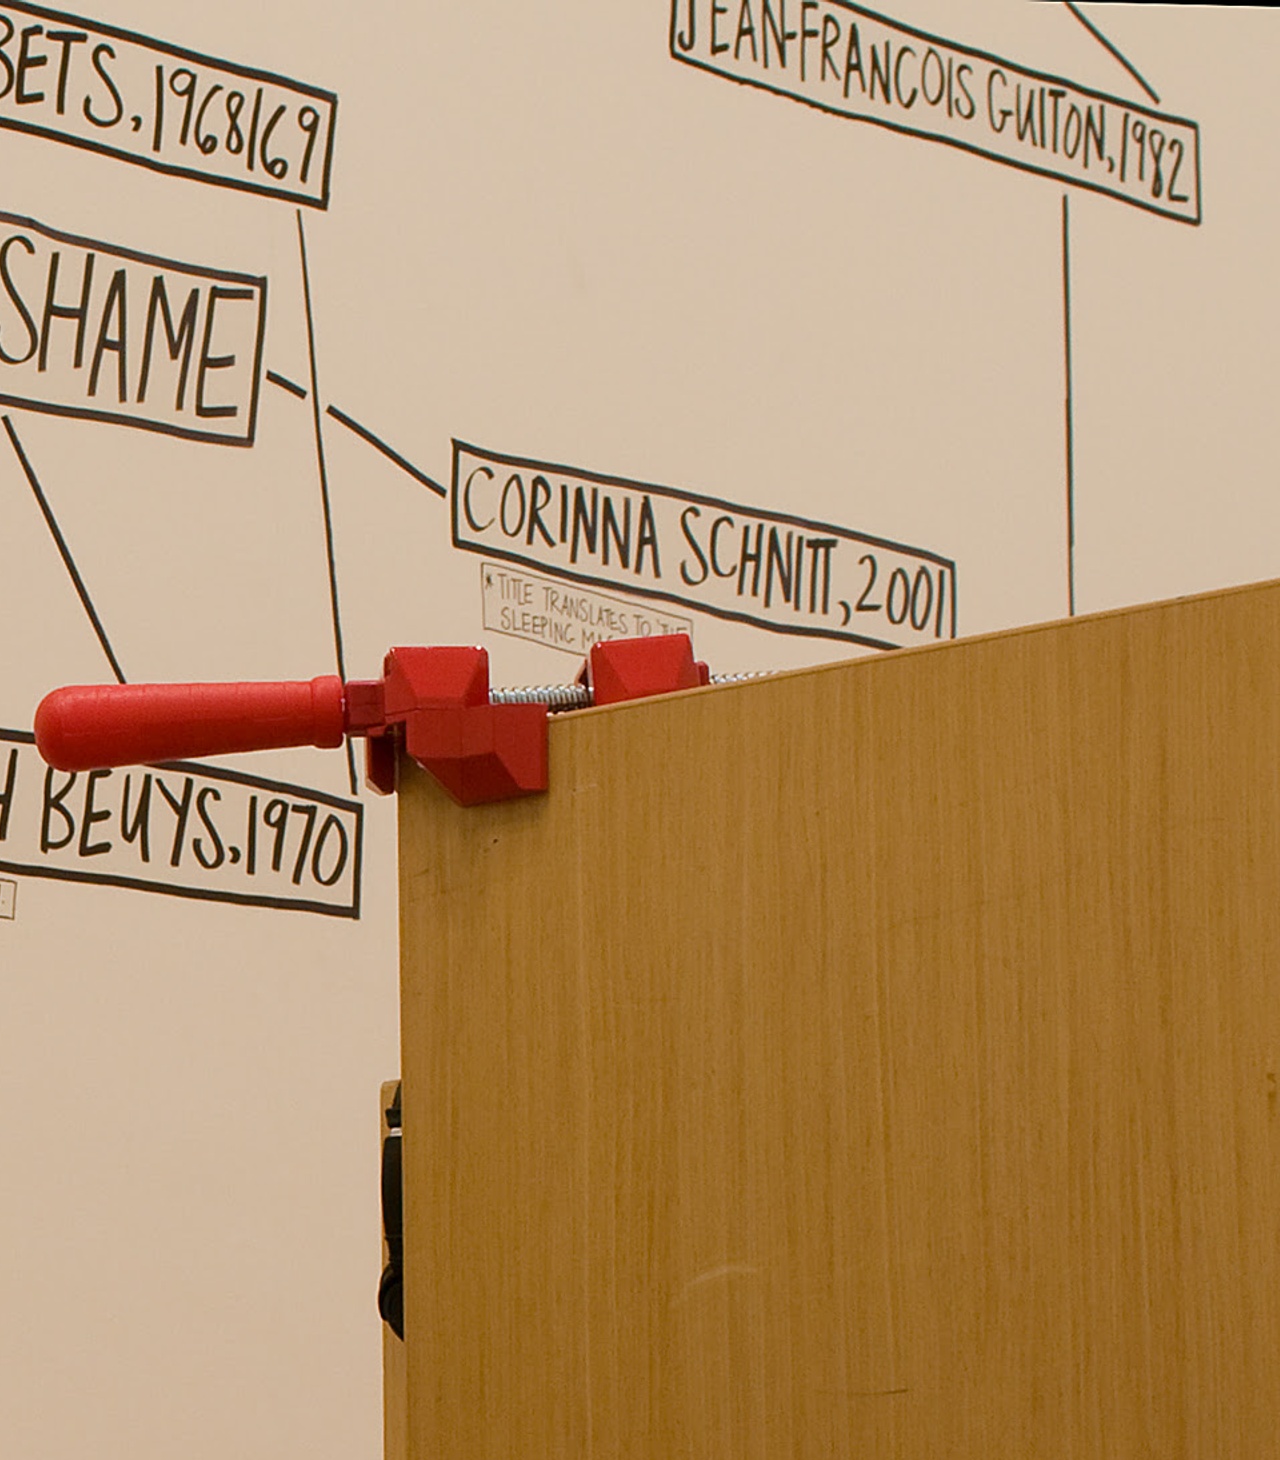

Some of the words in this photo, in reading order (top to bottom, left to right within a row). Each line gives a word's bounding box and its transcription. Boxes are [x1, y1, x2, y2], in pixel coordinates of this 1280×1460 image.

[463, 466, 661, 579] CORINNA
[497, 572, 534, 606] TITLE
[542, 586, 629, 635] TRANSLATES
[633, 613, 653, 637] TO
[500, 606, 576, 645] SLEEPING
